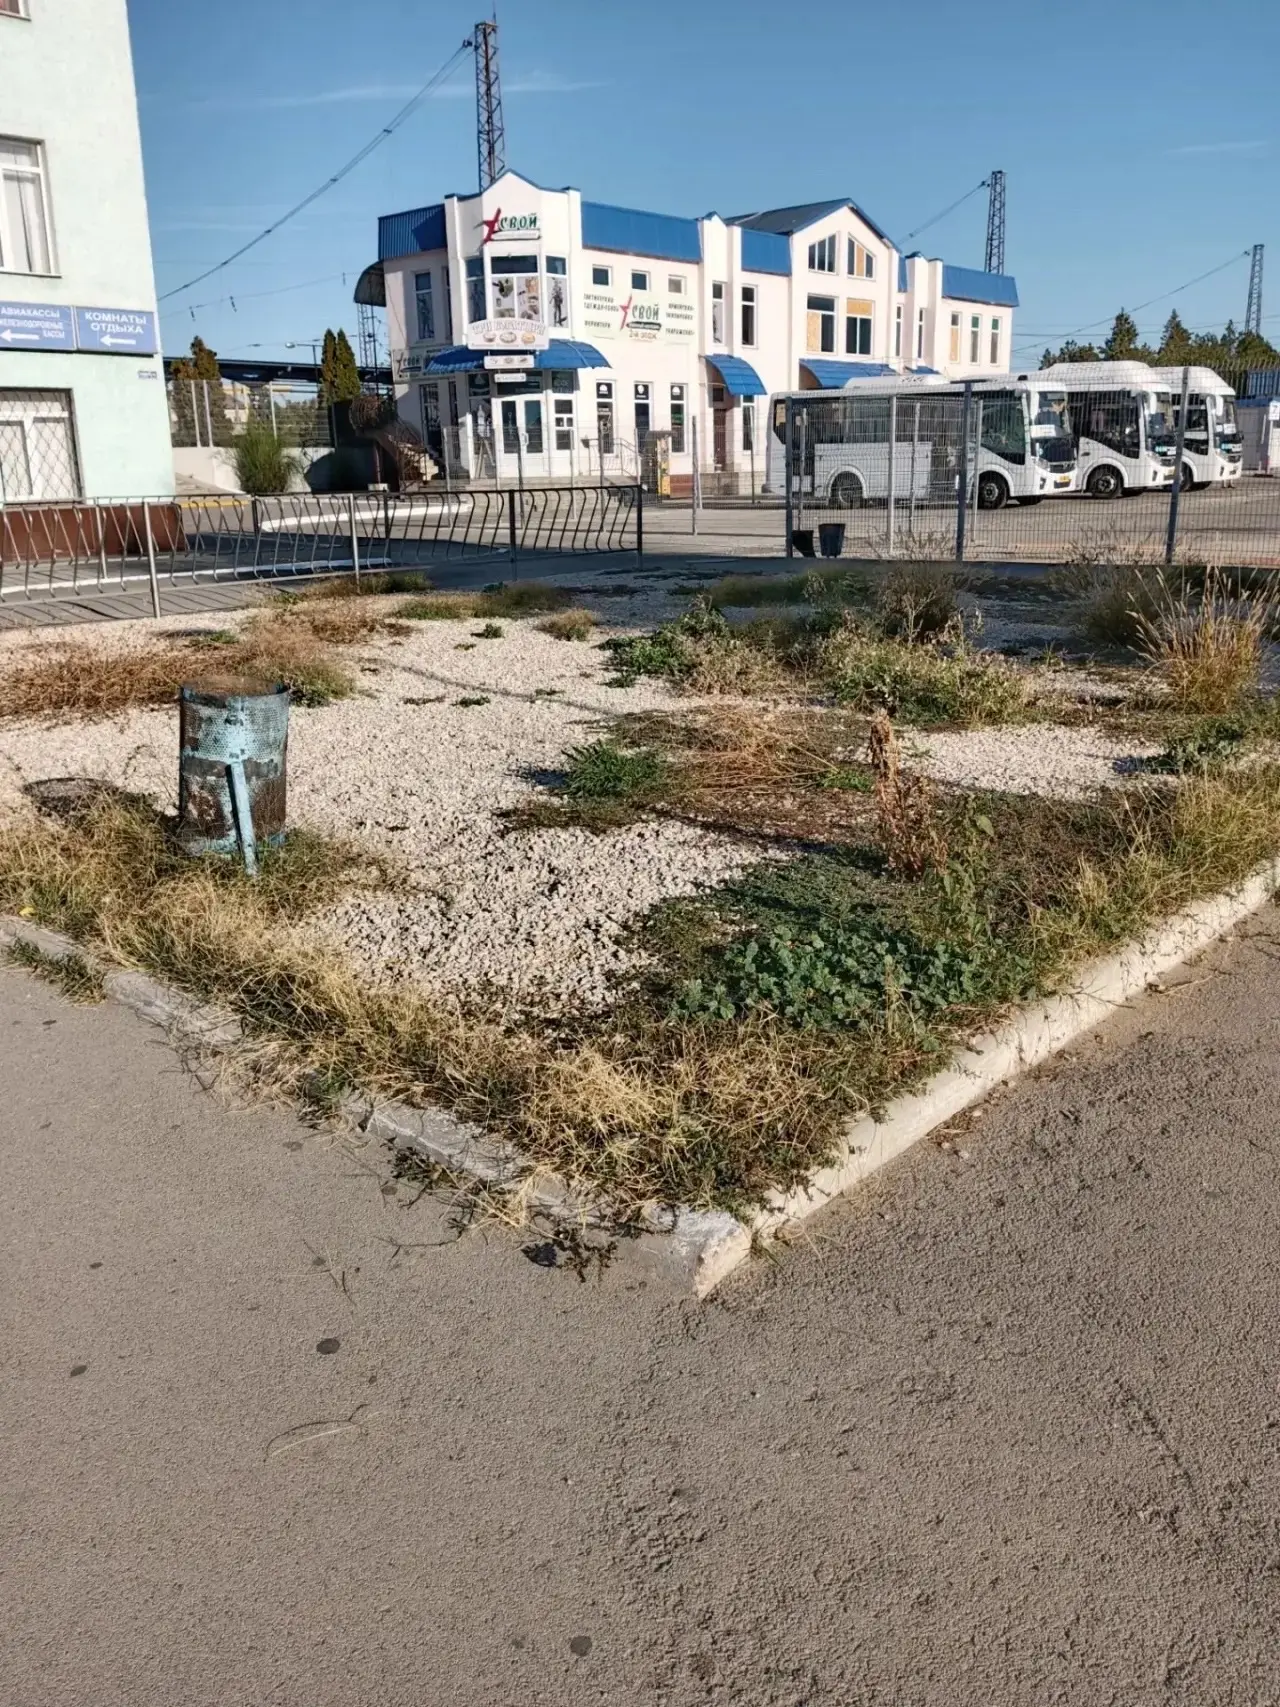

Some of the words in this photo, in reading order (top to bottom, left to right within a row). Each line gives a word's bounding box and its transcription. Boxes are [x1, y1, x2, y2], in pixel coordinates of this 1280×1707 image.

[500, 212, 537, 229] СВОЙ
[85, 312, 146, 325] КОМНАТЫ
[632, 304, 659, 320] СВОЙ
[90, 323, 144, 334] ОТДЫХА
